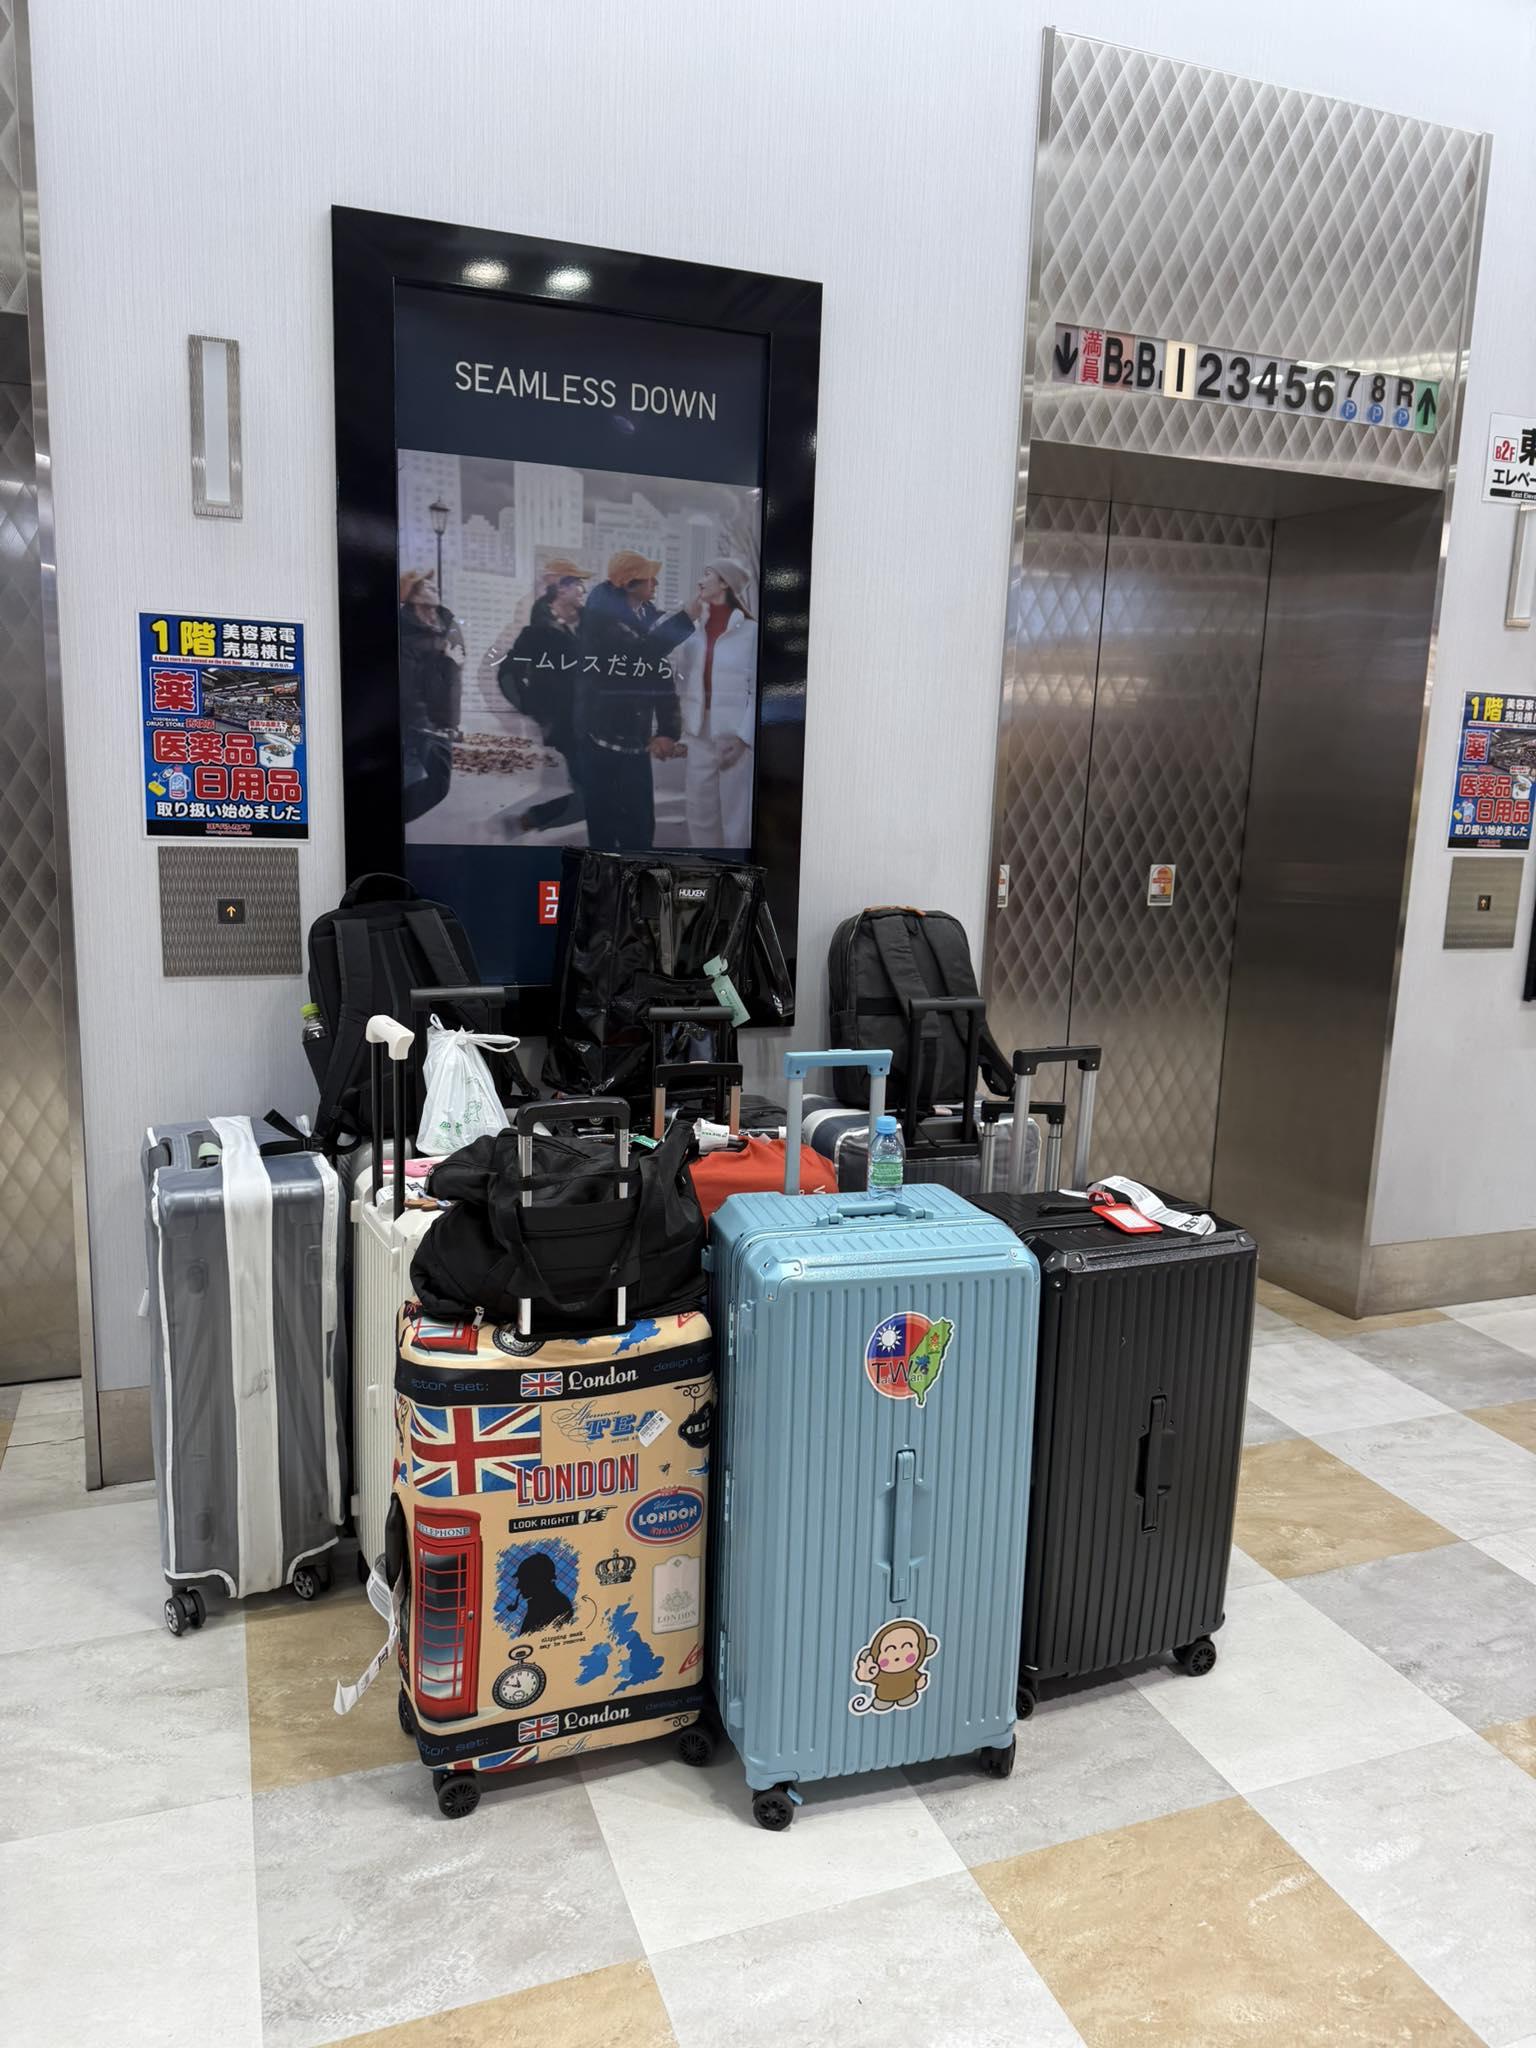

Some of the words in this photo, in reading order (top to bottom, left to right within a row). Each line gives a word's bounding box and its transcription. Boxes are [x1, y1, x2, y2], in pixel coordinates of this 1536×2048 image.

[1082, 329, 1103, 384] 満員
[1105, 337, 1134, 386] B2
[1137, 342, 1163, 389] B1
[1198, 353, 1222, 398] 2
[1228, 357, 1250, 400] 3
[1256, 362, 1278, 405] 4
[1284, 365, 1307, 408] 5
[1312, 370, 1335, 412] 6
[1347, 371, 1361, 398] 7
[1371, 375, 1386, 402] 8
[1396, 378, 1414, 407] R
[455, 361, 616, 408] SEAMLESS
[631, 383, 716, 421] DOWN
[1495, 440, 1516, 462] B2F
[152, 620, 216, 657] 1階
[222, 623, 296, 644] 美容家電
[223, 641, 296, 661] 売場横に
[488, 647, 684, 680] シームレスだから、
[154, 671, 195, 711] 薬
[1471, 696, 1504, 722] 1階
[1506, 698, 1536, 711] 美容家
[1505, 710, 1536, 724] 売場横
[153, 730, 257, 766] 医薬品
[1465, 732, 1486, 761] 薬
[194, 766, 302, 803] 日用品
[1459, 774, 1512, 798] 医薬品
[156, 802, 301, 820] 取り扱い始めました
[1476, 799, 1530, 824] 日用品
[1454, 824, 1528, 837] 取り扱い始めました
[679, 888, 706, 897] HULKEN
[568, 1366, 639, 1390] London
[516, 1453, 639, 1507] LONDON
[513, 1519, 538, 1530] LOOK
[540, 1515, 575, 1526] RIGHT!
[639, 1505, 697, 1525] LONDON
[657, 1609, 697, 1624] LONDON
[563, 1705, 631, 1730] London
